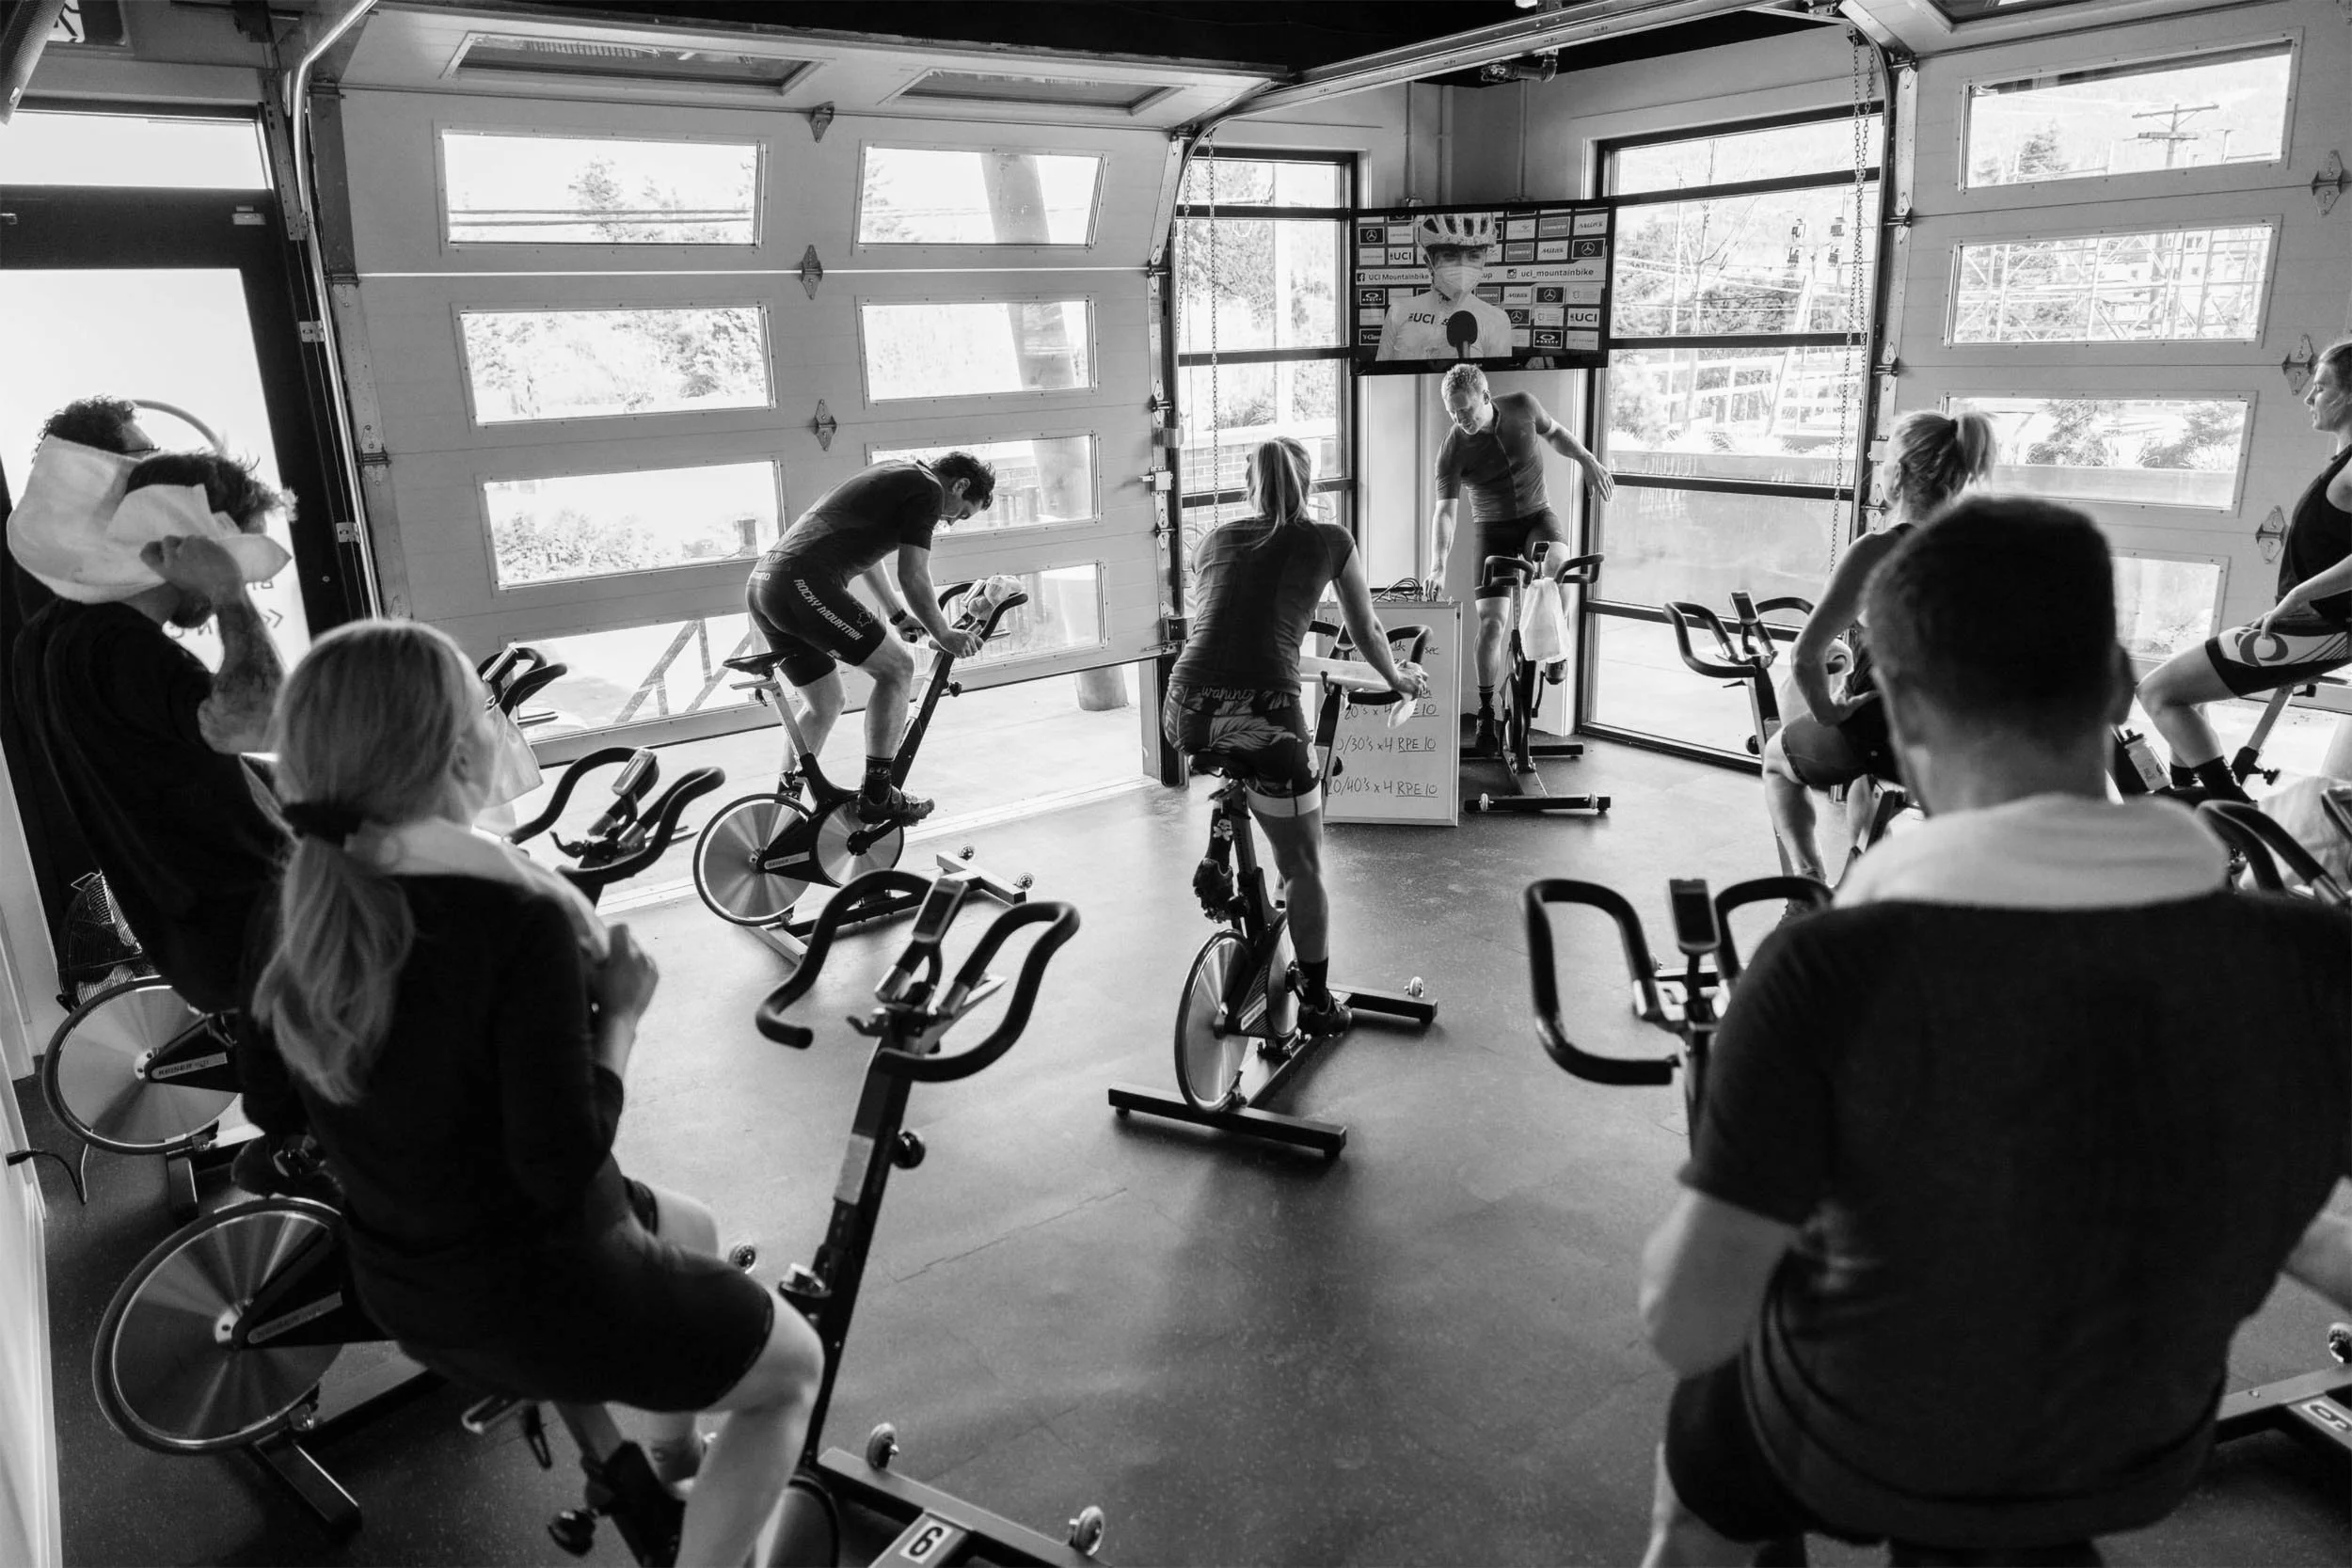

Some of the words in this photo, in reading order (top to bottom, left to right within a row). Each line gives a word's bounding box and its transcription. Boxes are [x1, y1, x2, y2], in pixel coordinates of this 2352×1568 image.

[1393, 252, 1411, 261] UCI
[1520, 268, 1595, 279] uci_mountainbike
[1413, 312, 1435, 325] UCI
[1575, 313, 1597, 322] UCI
[794, 578, 822, 607] ROCKY
[817, 606, 863, 641] MOUNTAIN
[1422, 703, 1437, 716] 10
[1385, 736, 1393, 752] 4
[1398, 736, 1419, 750] RPE
[1424, 736, 1437, 750] 10
[1384, 780, 1392, 794] 4
[1398, 781, 1421, 794] RPE
[1425, 784, 1437, 796] 10
[909, 1527, 944, 1557] 6
